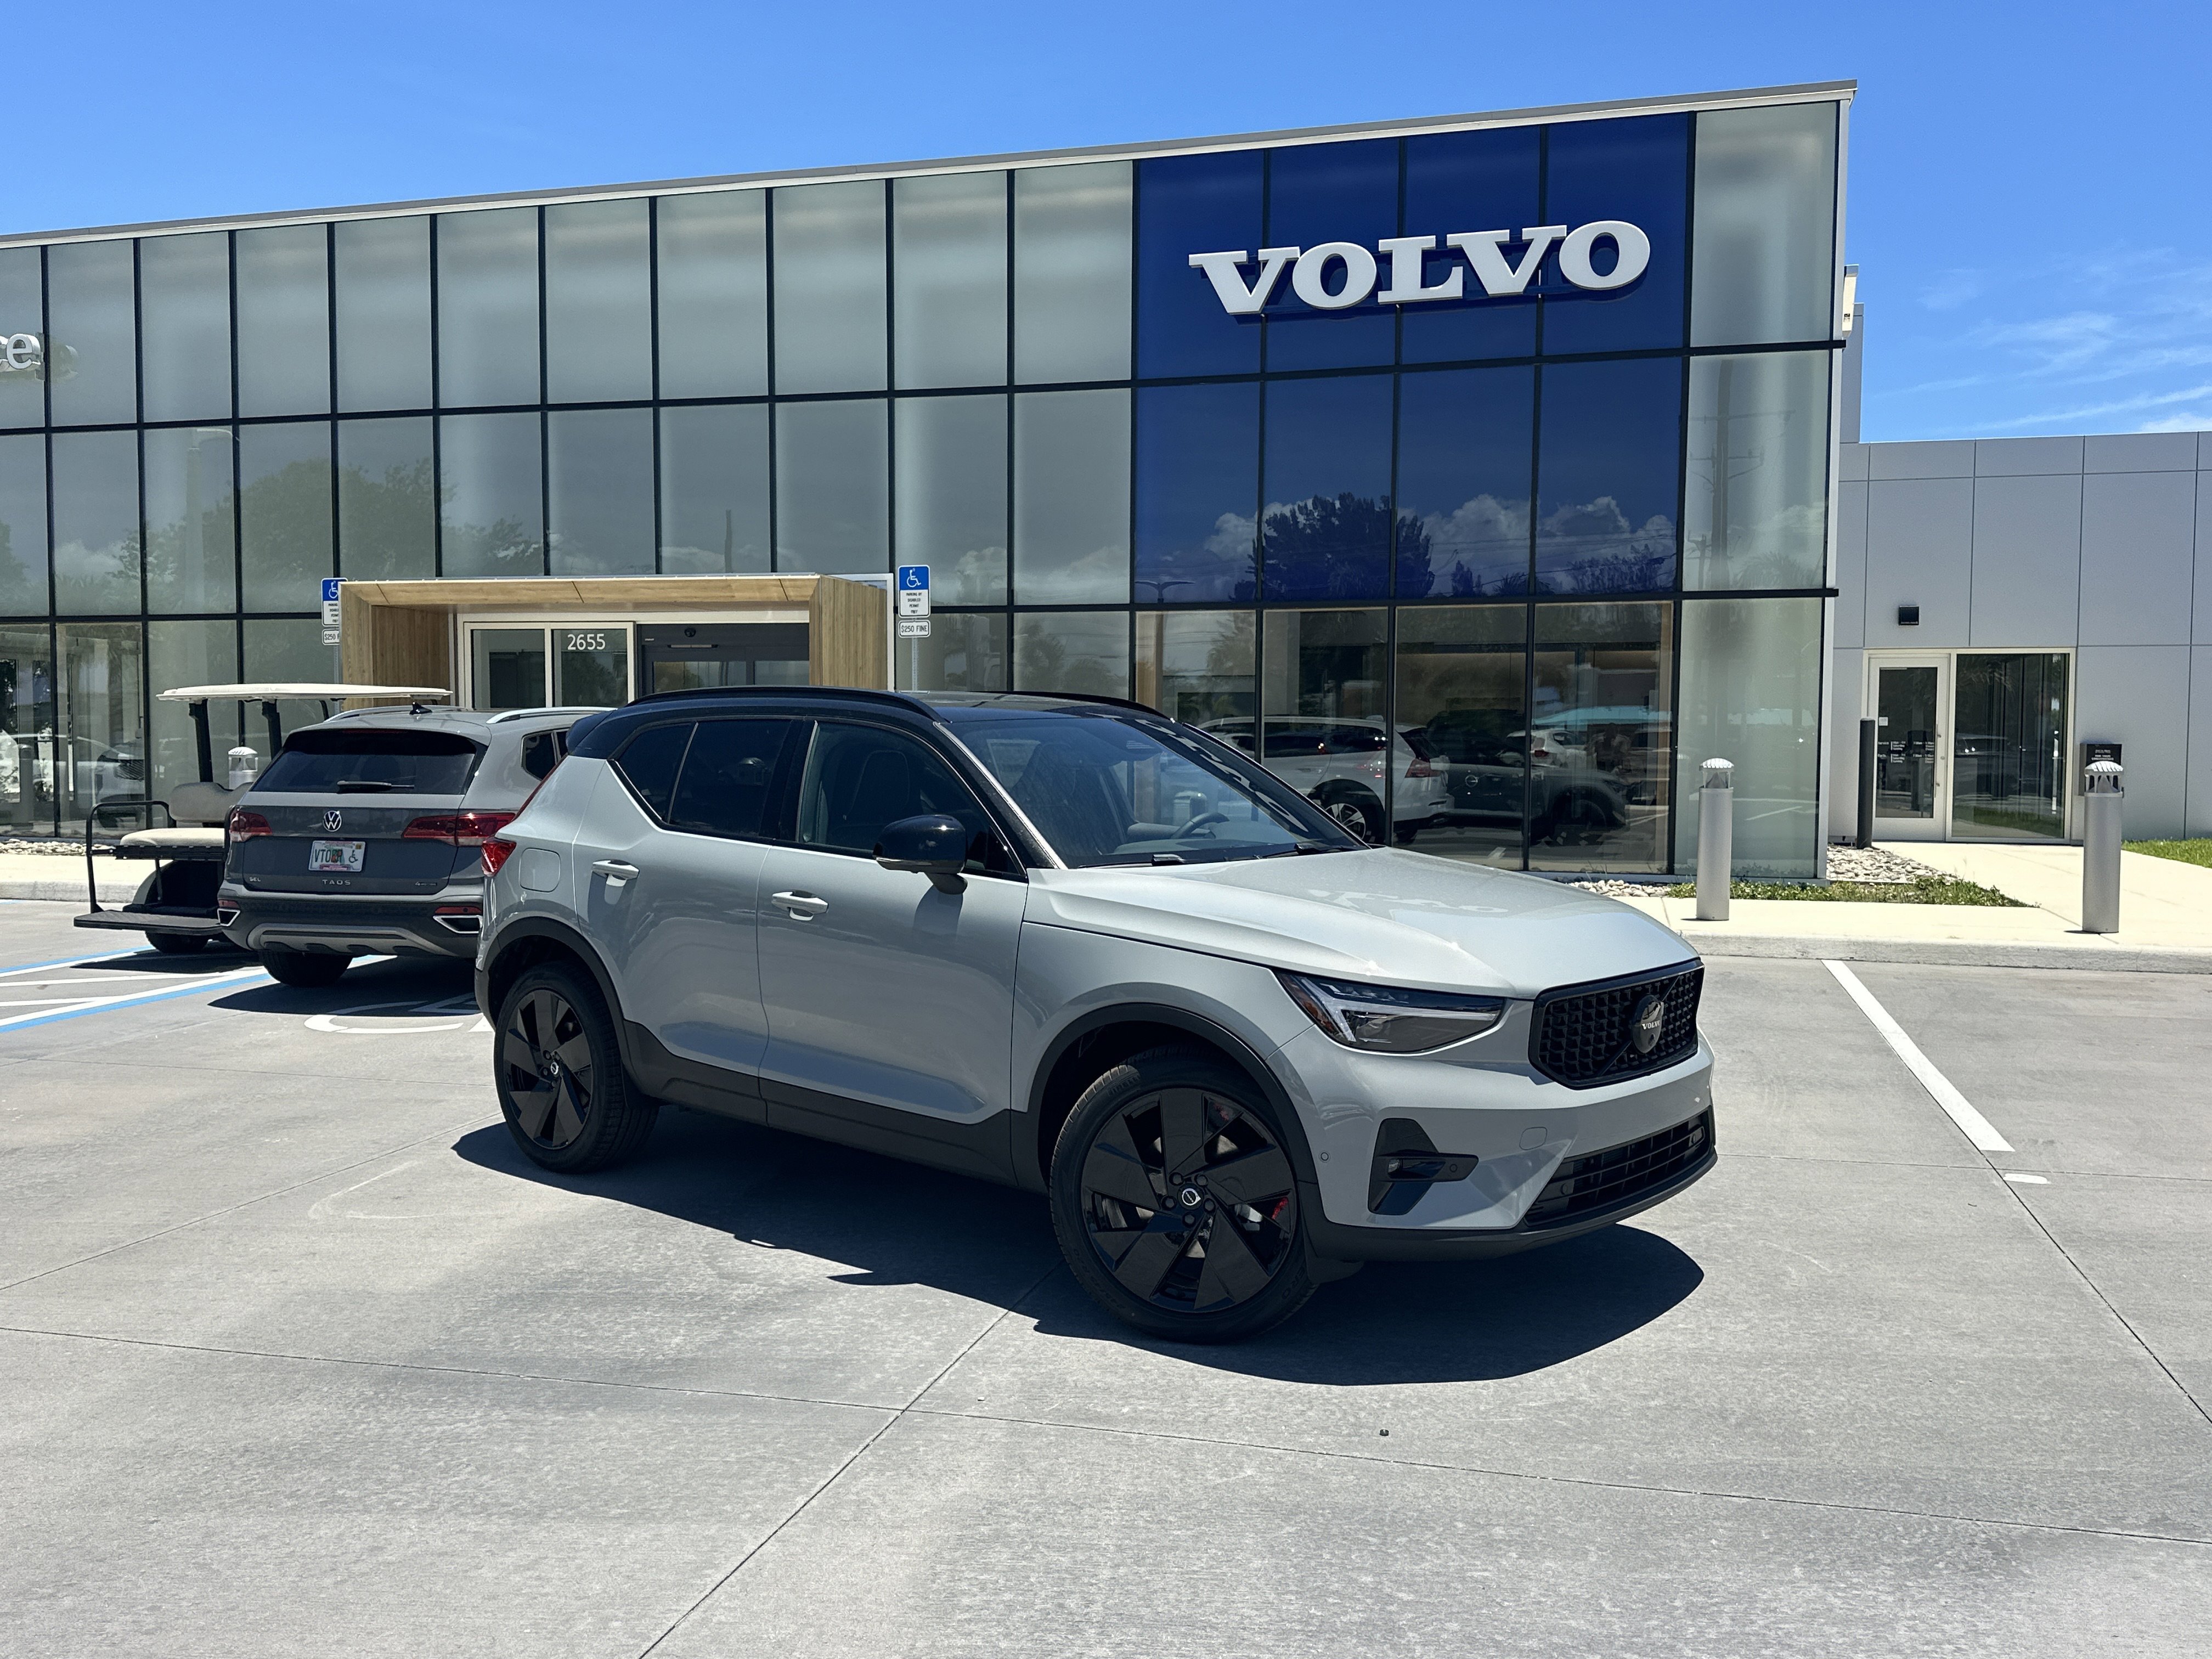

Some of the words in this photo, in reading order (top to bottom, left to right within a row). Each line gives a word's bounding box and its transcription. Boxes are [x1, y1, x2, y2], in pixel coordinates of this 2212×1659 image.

[1188, 219, 1651, 314] VOLVO
[901, 625, 914, 633] $250
[324, 633, 336, 641] $250
[567, 633, 606, 651] 2655
